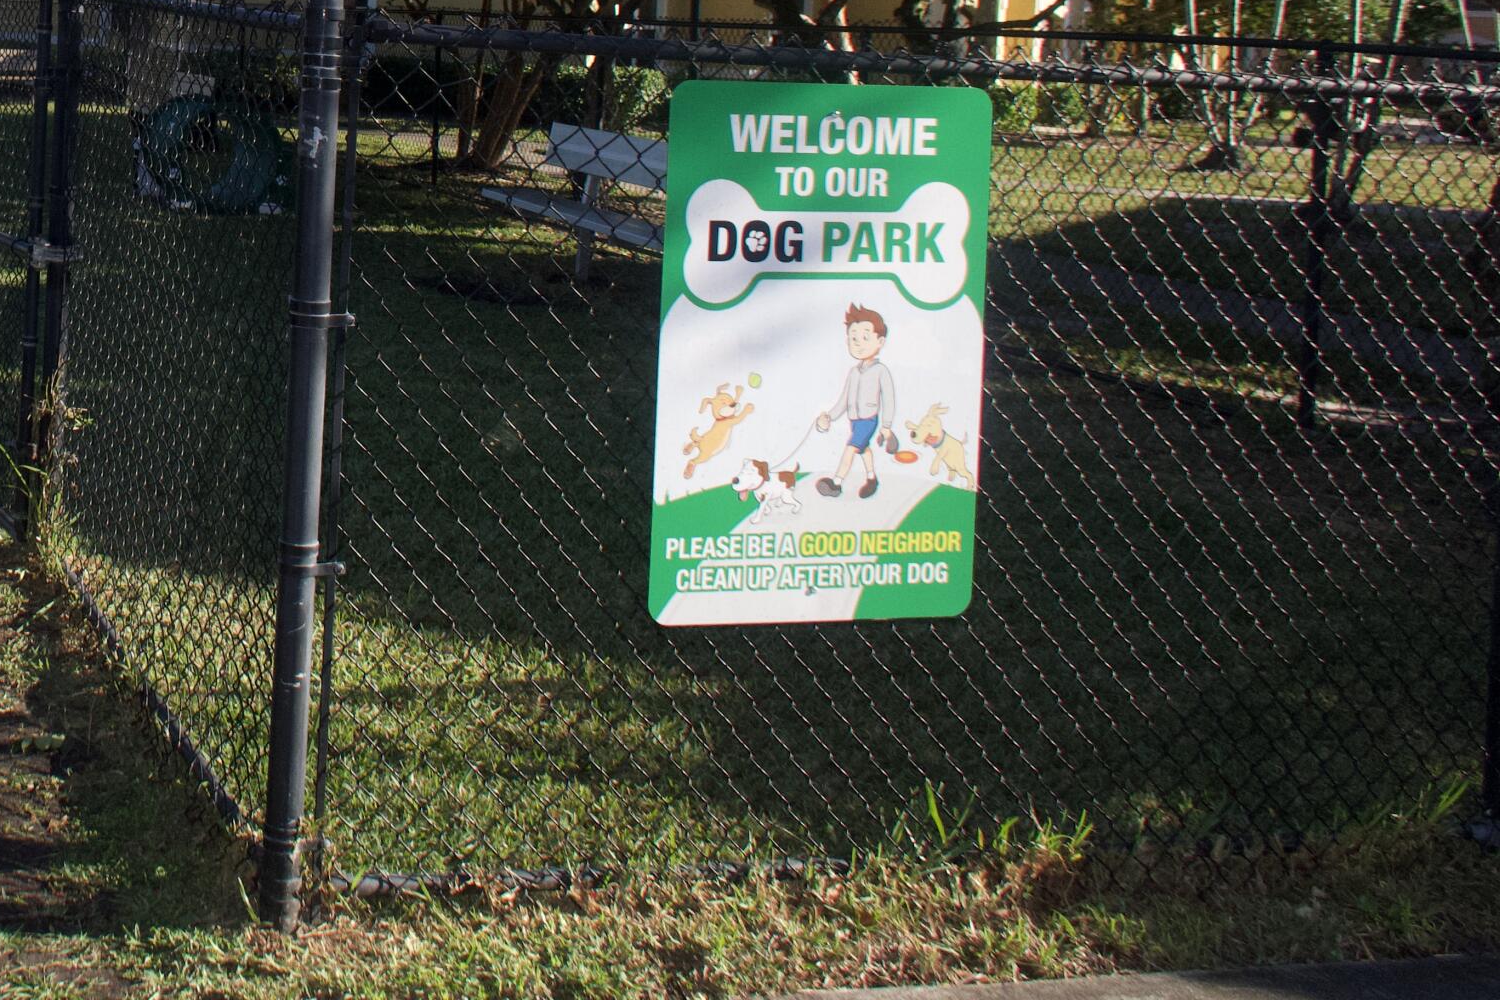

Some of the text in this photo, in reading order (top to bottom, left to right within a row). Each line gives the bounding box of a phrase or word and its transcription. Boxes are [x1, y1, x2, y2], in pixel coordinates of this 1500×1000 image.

[730, 114, 938, 156] WELCOME
[775, 166, 889, 197] TO OUR
[708, 219, 946, 263] DOG PARK
[665, 531, 962, 560] PLEASE BE A GOOD NEIGHBOR
[676, 562, 948, 591] CLEAN UP AFTER YOUR DOG
